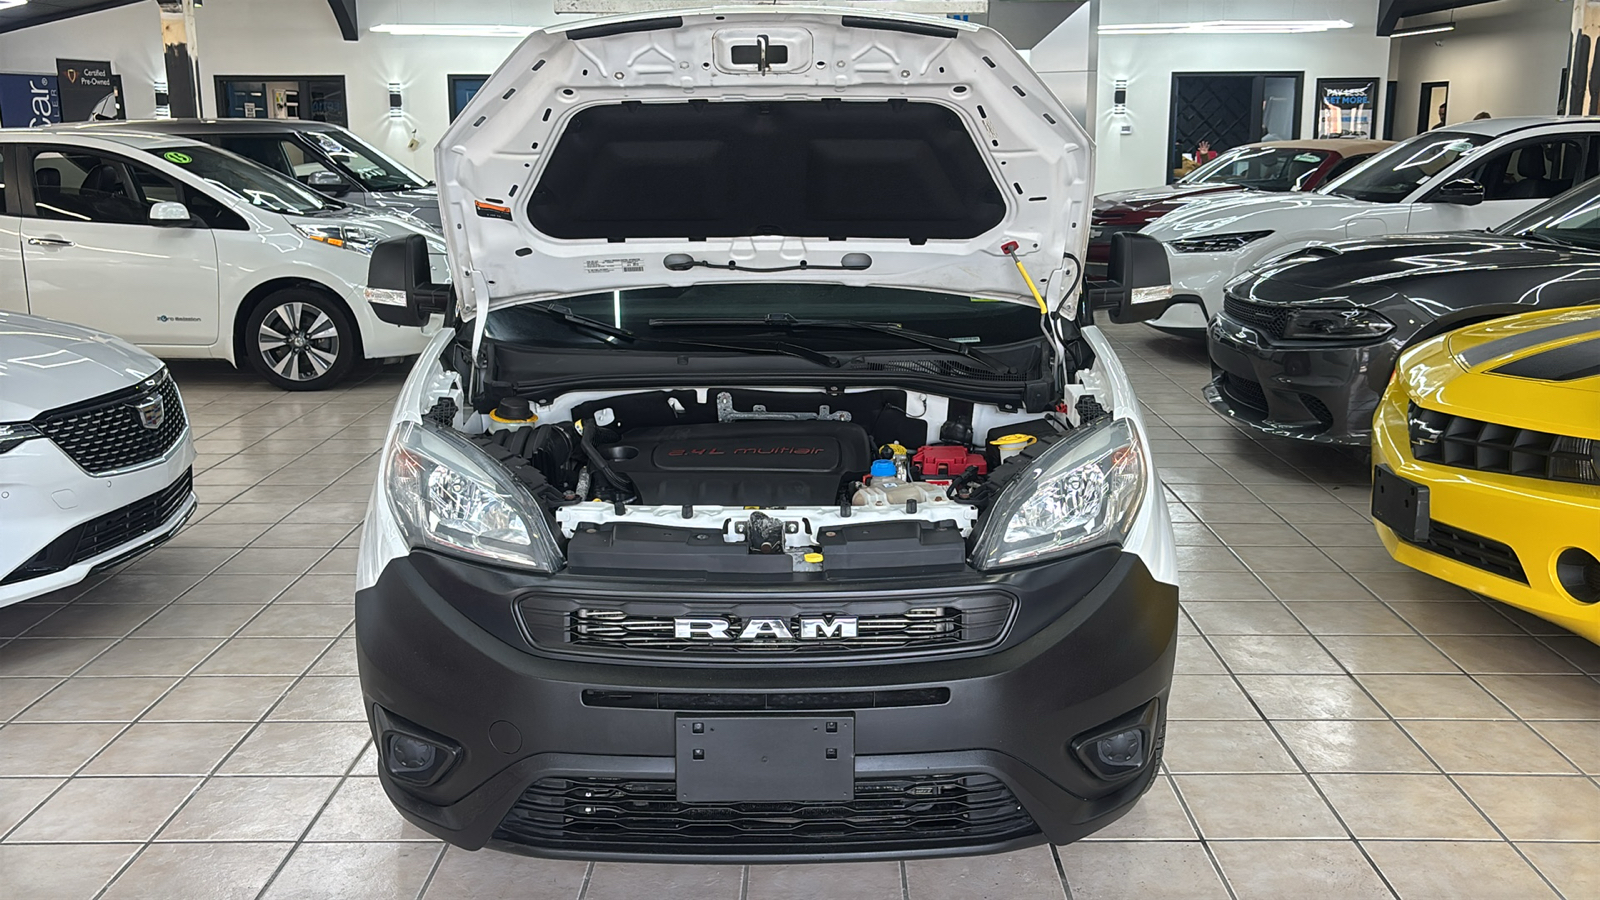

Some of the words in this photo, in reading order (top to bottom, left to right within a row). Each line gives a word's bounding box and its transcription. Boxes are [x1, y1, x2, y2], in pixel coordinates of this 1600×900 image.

[83, 68, 106, 77] Certified
[81, 77, 110, 86] Pre-Owned
[668, 447, 725, 456] 2.4L
[674, 617, 858, 639] RAM
